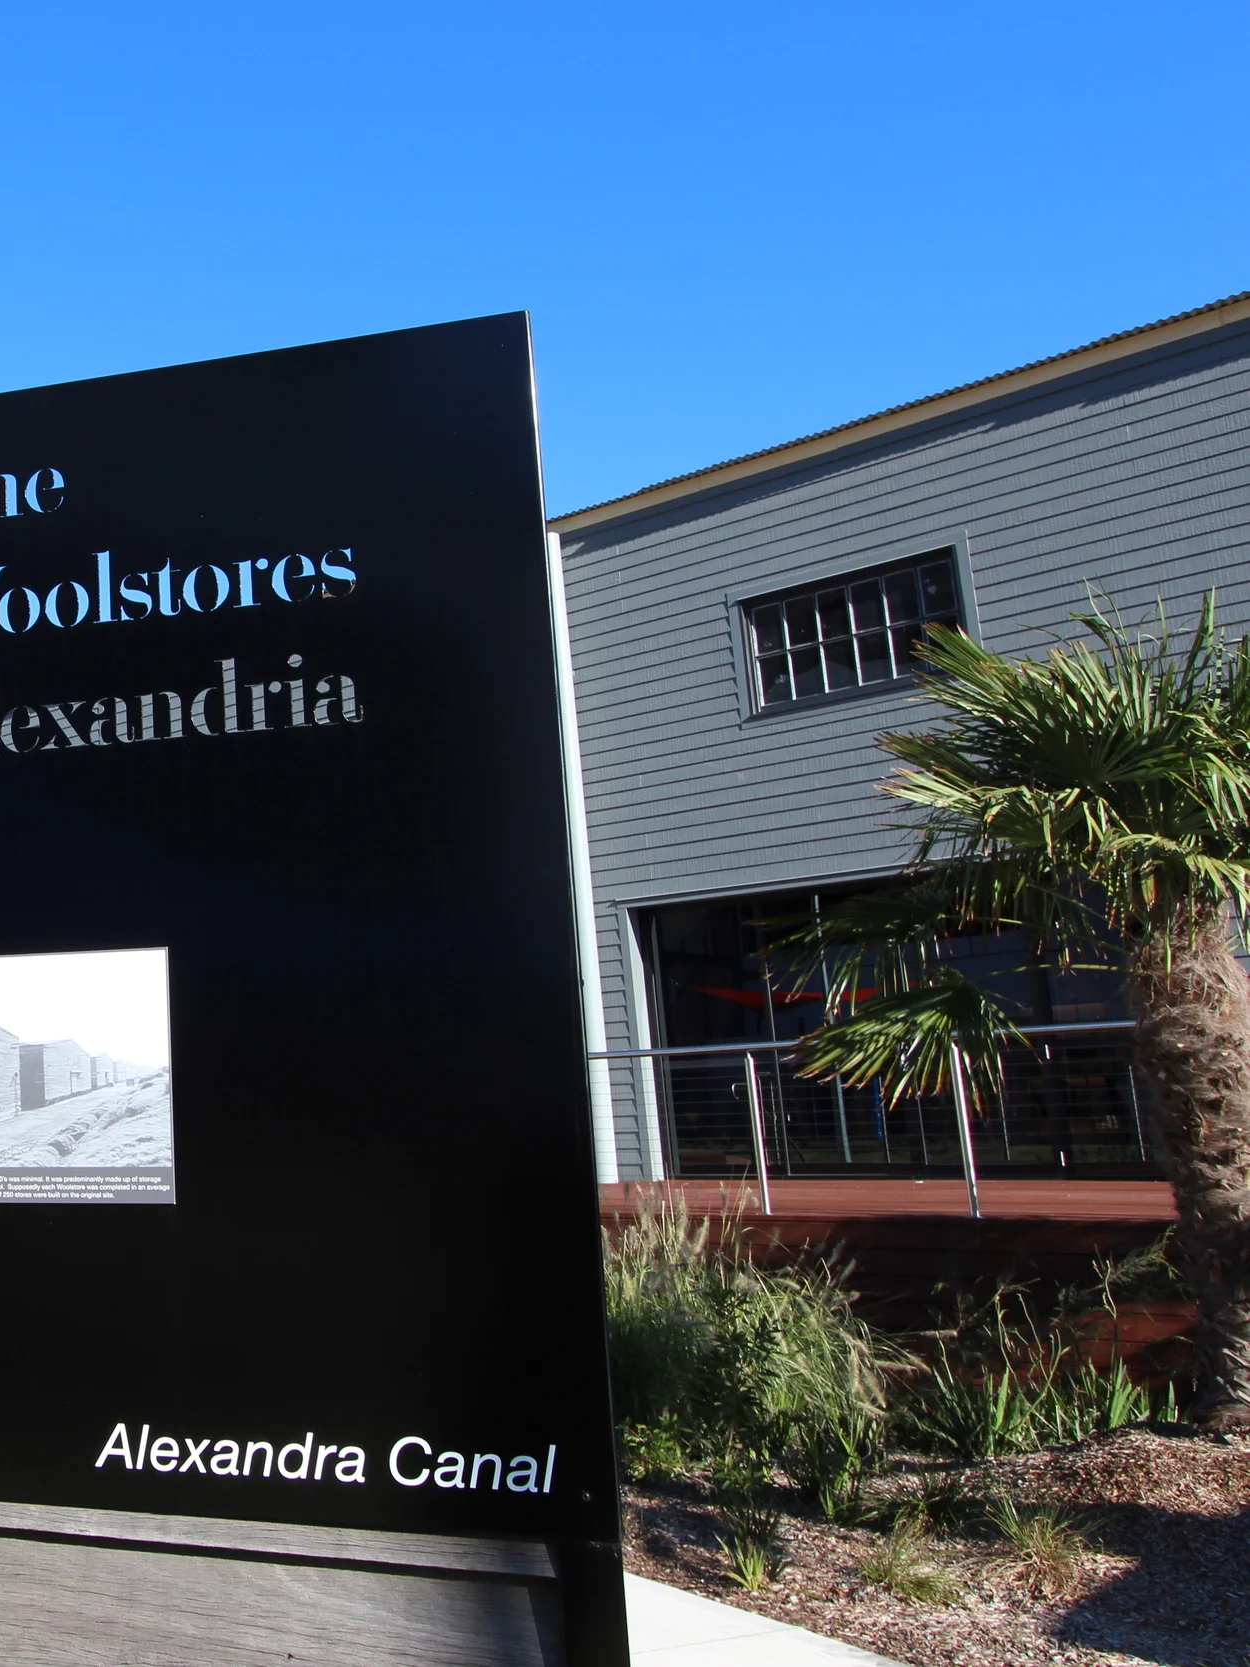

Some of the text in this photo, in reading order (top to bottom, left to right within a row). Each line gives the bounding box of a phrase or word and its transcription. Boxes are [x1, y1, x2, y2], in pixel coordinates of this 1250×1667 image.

[64, 1176, 104, 1184] predominantly
[139, 1176, 161, 1184] storage
[8, 1183, 40, 1191] Supposedly
[100, 1184, 130, 1192] completed
[81, 1191, 101, 1199] original
[94, 1422, 557, 1494] Alexandra Canal
